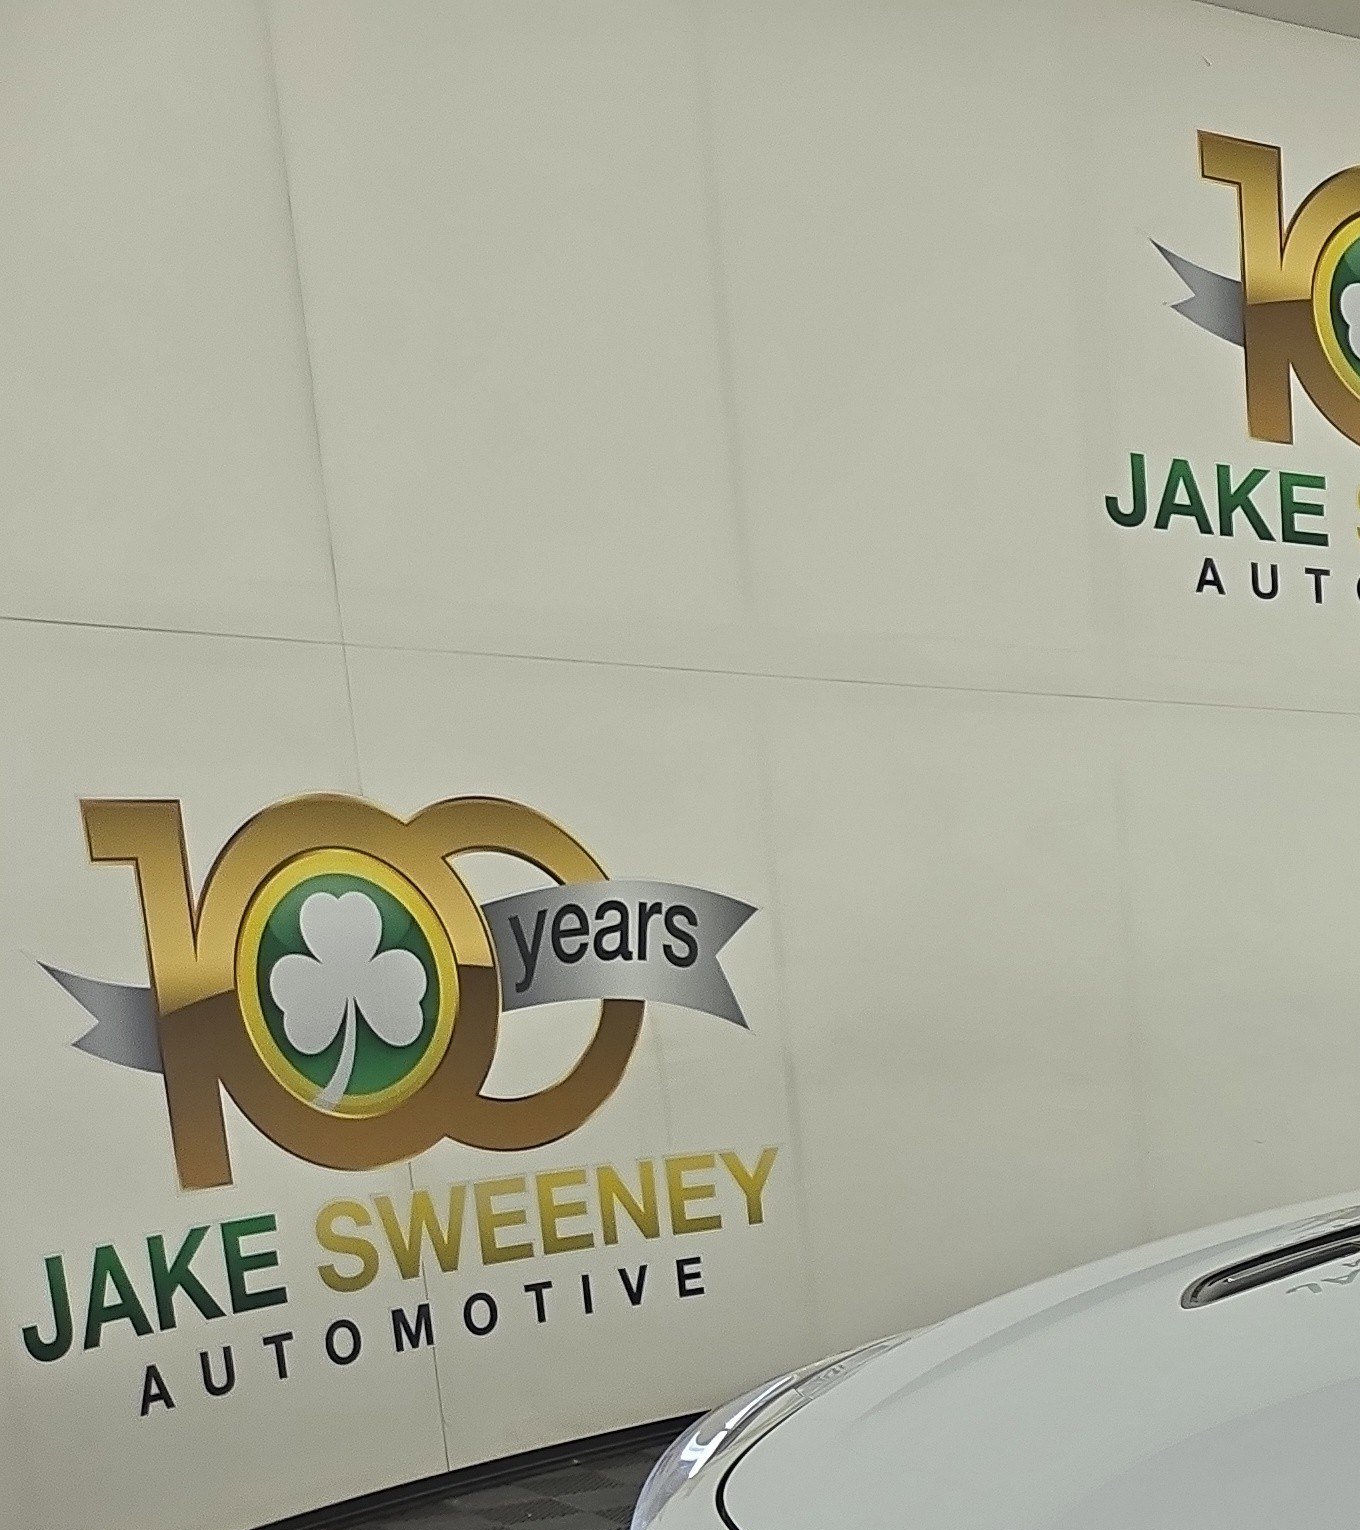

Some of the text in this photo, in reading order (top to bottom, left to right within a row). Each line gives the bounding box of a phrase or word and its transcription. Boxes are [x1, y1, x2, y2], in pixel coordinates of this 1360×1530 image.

[1104, 452, 1330, 547] JAKE
[508, 899, 700, 995] years
[22, 1147, 779, 1362] JAKE SWEENEY
[139, 1256, 706, 1418] AUTOMOTIVE
